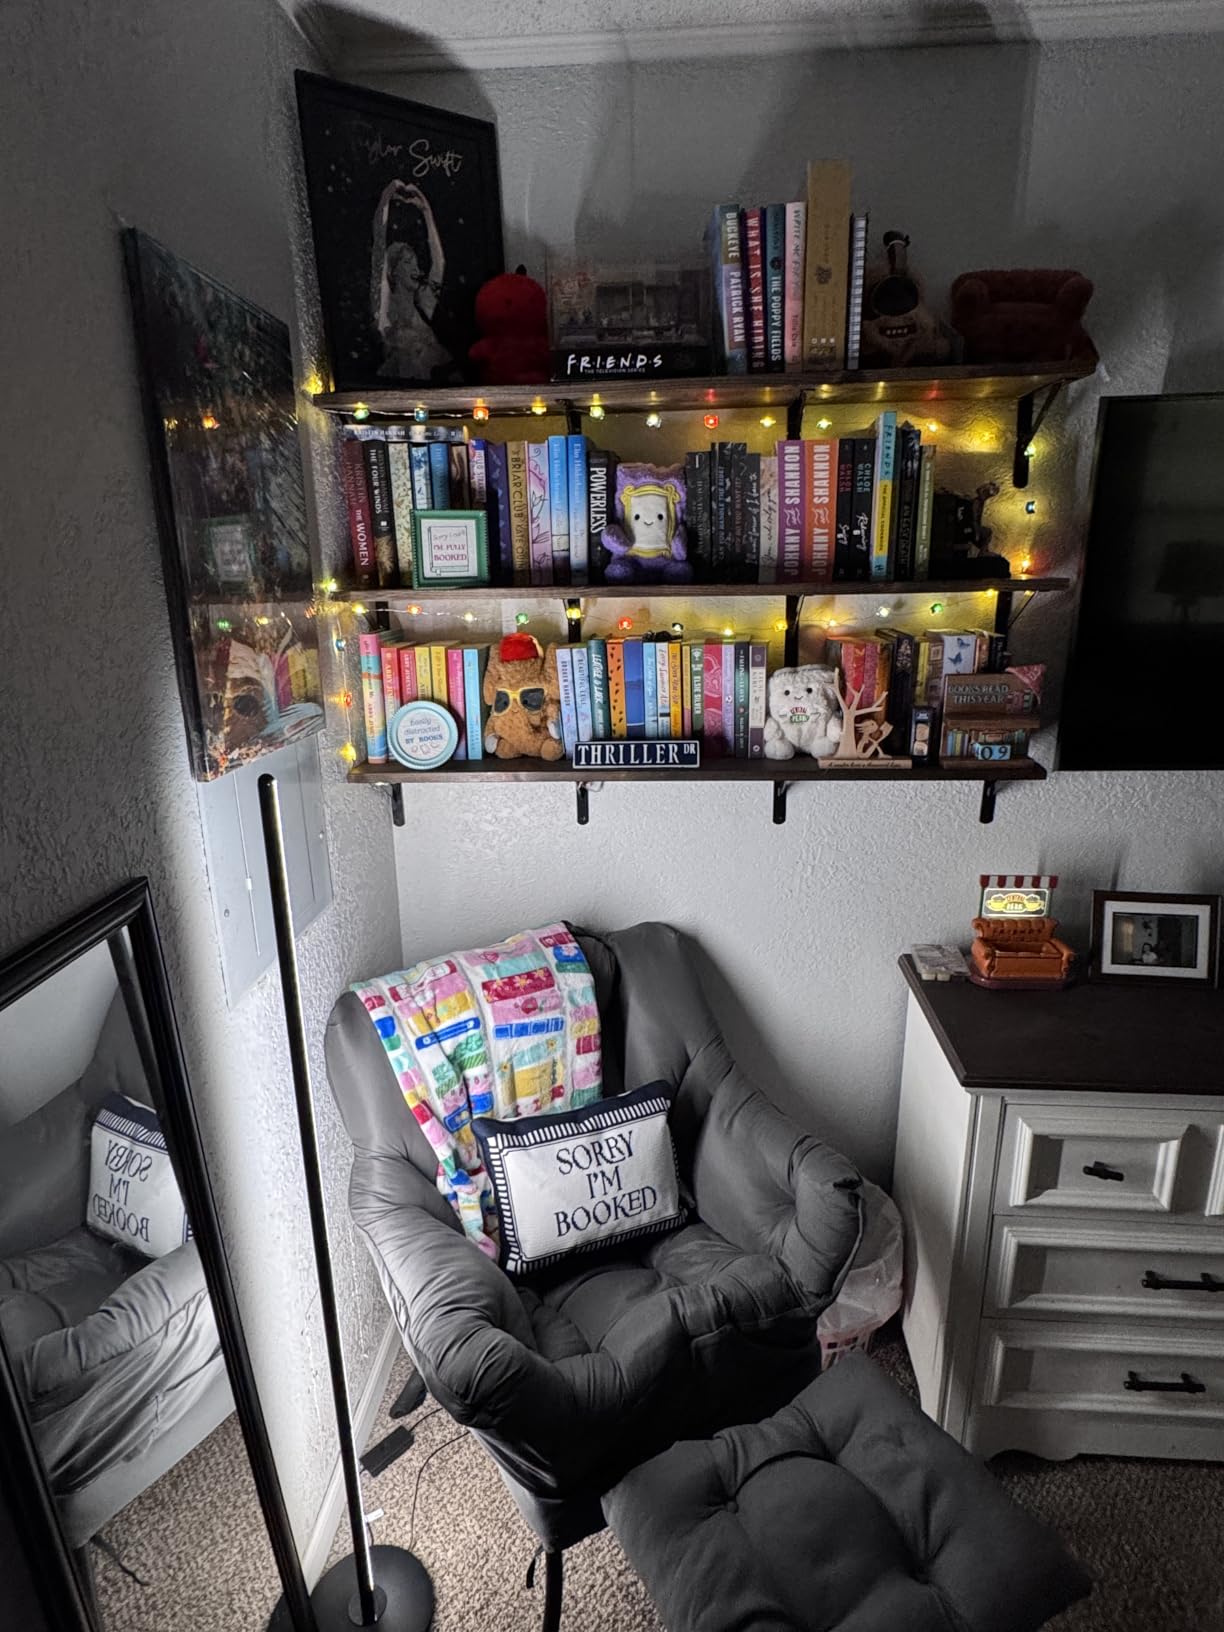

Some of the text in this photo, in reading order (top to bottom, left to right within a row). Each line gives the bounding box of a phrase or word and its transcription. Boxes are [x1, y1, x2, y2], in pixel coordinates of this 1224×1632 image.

[409, 138, 464, 178] Swift
[725, 211, 745, 343] BUCKEYE PATRICK RYAN
[746, 216, 765, 368] WHAT IS SHE HIDING
[771, 275, 782, 362] THE POPPY FIELDS
[477, 451, 485, 470] HELLO
[511, 456, 522, 488] BRIAR
[784, 445, 801, 505] SHANNON
[812, 445, 831, 505] SHANNON
[344, 462, 367, 506] KRISTIN HANNAH
[369, 449, 383, 515] THE FOUR WINDS
[856, 463, 864, 494] WALSH
[863, 462, 872, 493] CHLOE
[512, 489, 523, 518] CLUB
[590, 467, 607, 534] POWERLESS
[355, 508, 369, 567] THE WOMEN
[446, 543, 466, 551] FULLY
[514, 523, 525, 543] KATE
[434, 553, 467, 561] BOOKED
[784, 527, 801, 576] JOHNNY
[812, 527, 830, 576] JOHNNY
[384, 663, 393, 684] ABBY
[592, 653, 603, 678] LEATHER
[560, 660, 571, 707] BROKEN HARBOR
[593, 686, 603, 704] LARK
[694, 675, 702, 692] ELSIE
[948, 683, 1009, 694] BOOKS READ
[694, 694, 702, 715] SILVER
[954, 694, 1005, 705] THIS YEAR
[404, 725, 441, 735] distracted
[419, 734, 443, 743] BOOKS
[577, 743, 696, 767] THRILLER DR
[556, 1130, 633, 1175] SORRY
[586, 1165, 623, 1200] I'M
[554, 1185, 657, 1237] BOOKED
